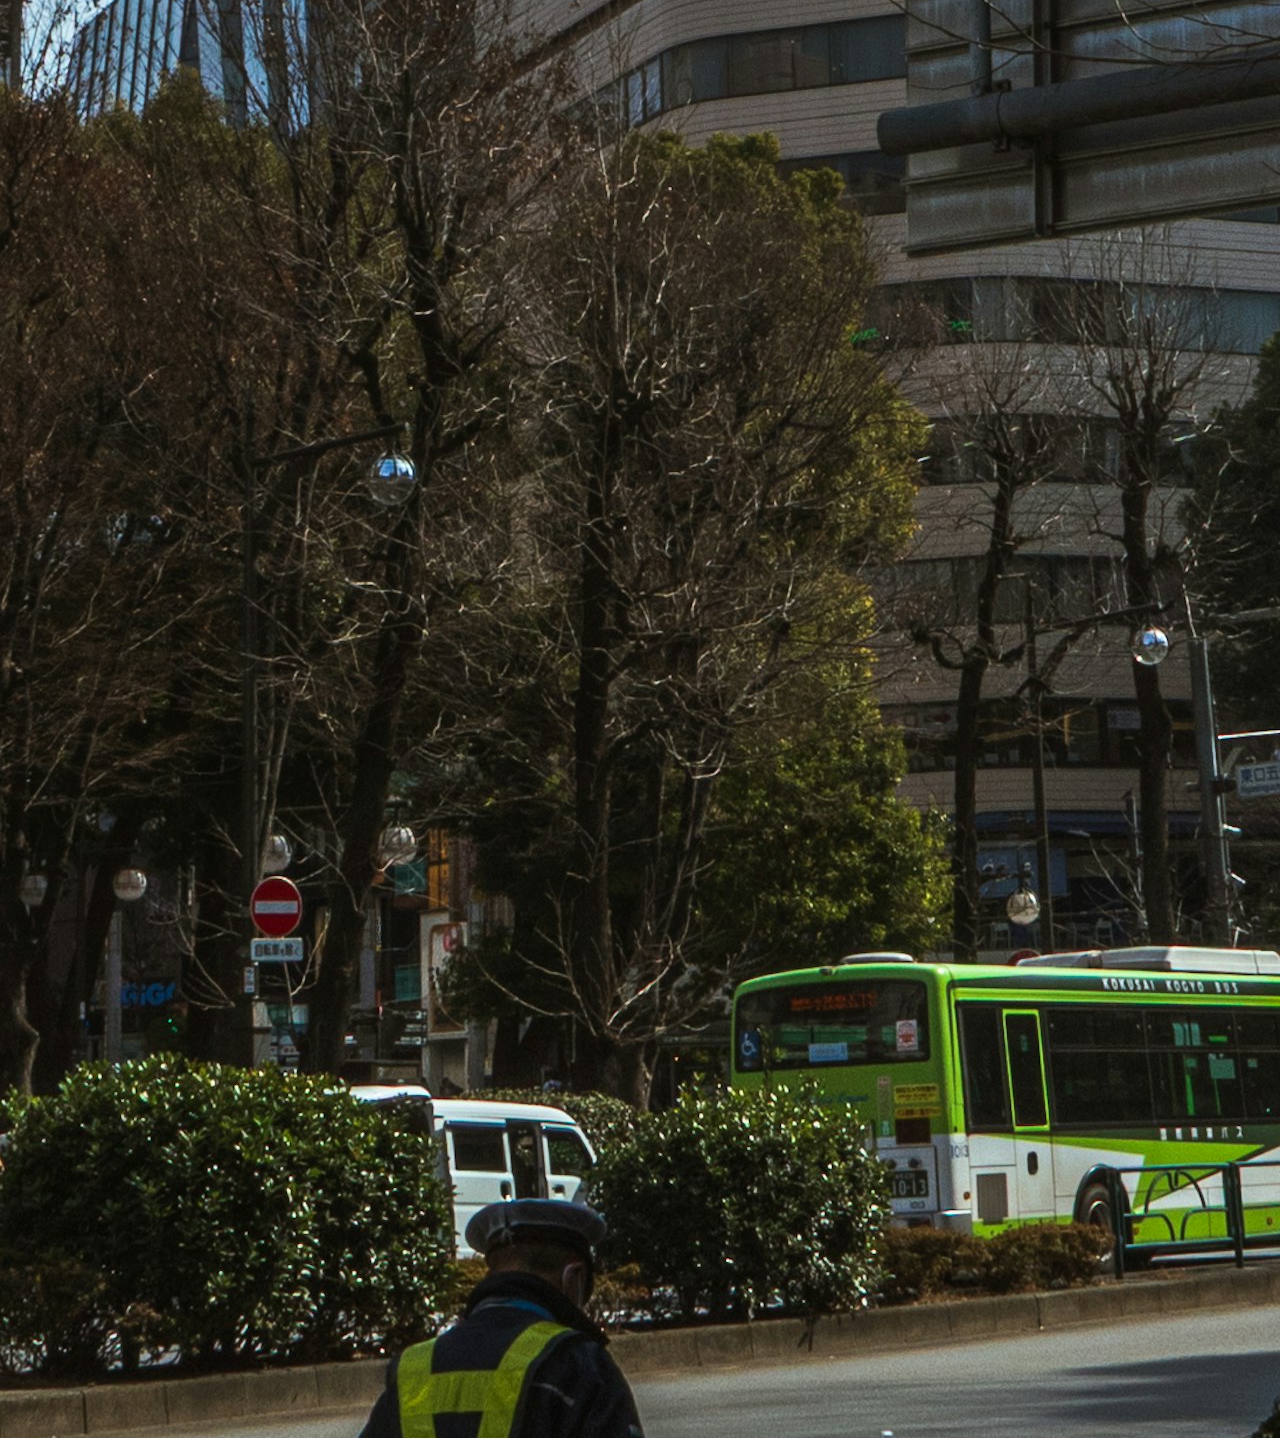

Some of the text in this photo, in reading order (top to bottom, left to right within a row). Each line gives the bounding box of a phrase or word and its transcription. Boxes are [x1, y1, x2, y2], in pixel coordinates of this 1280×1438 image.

[1102, 977, 1239, 994] KOKUSAI KOGYO BUS
